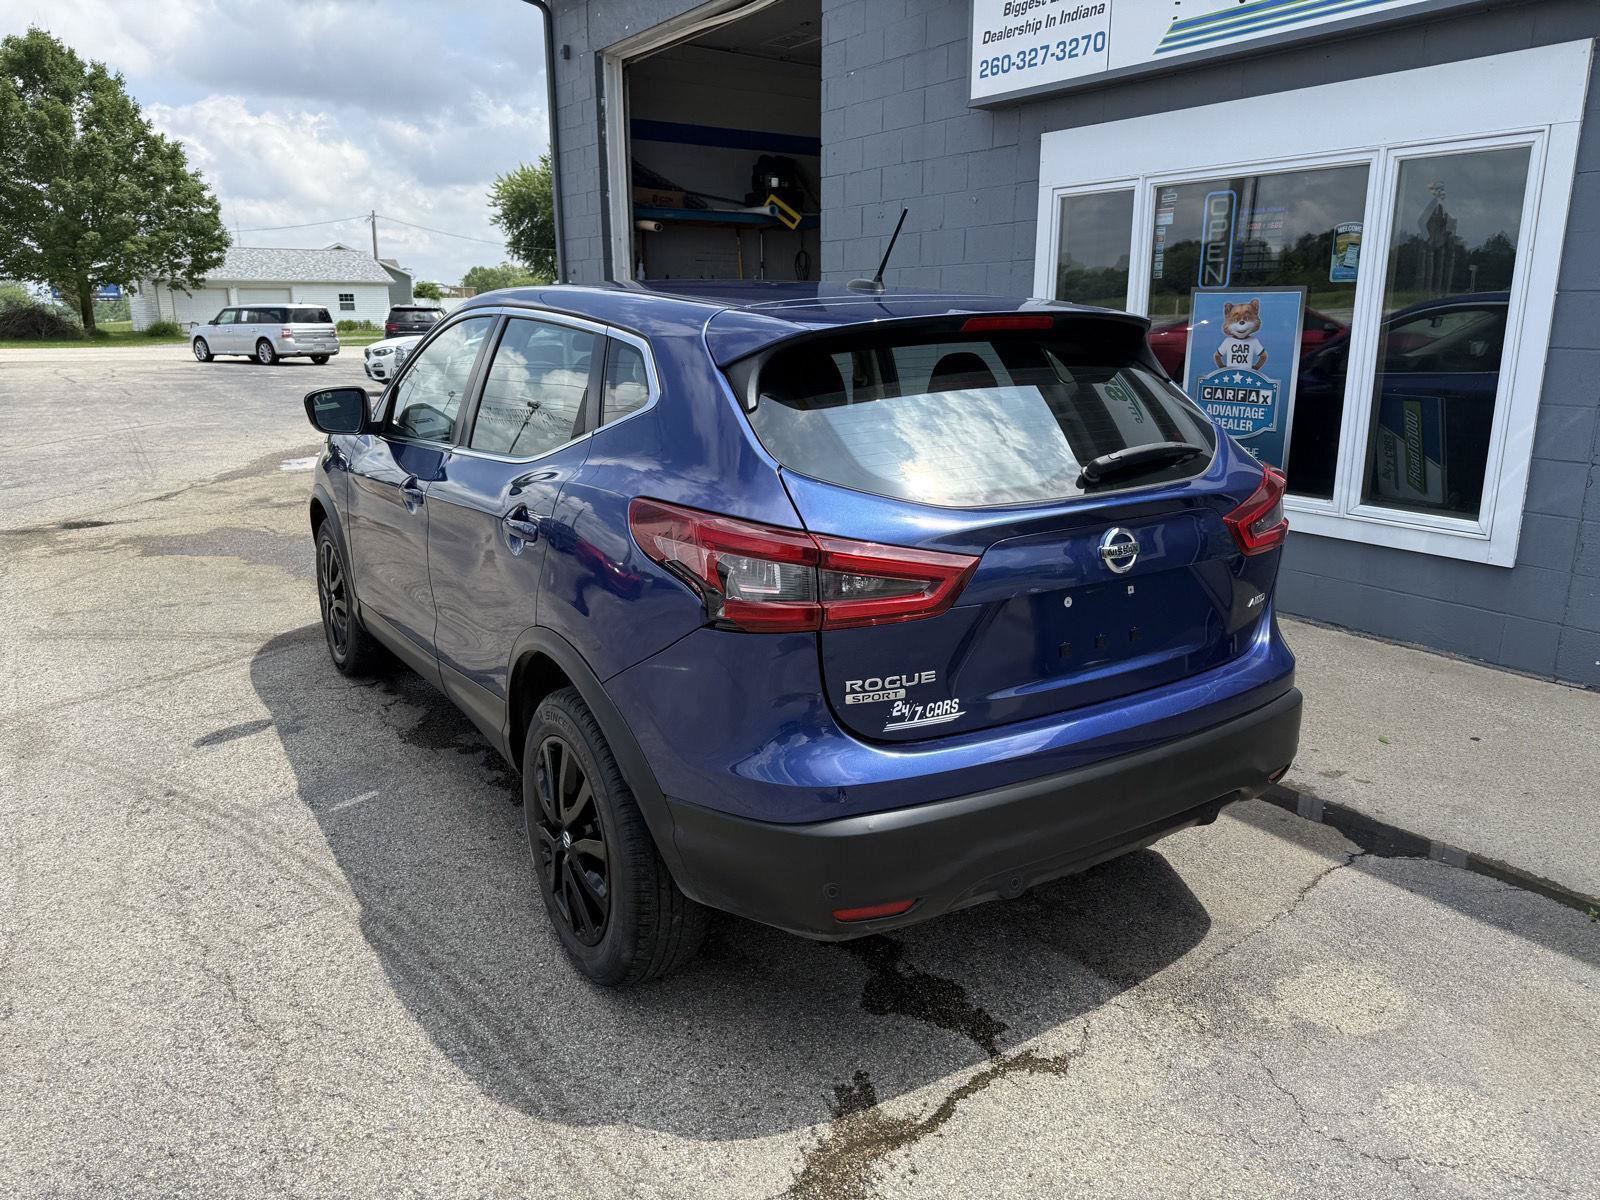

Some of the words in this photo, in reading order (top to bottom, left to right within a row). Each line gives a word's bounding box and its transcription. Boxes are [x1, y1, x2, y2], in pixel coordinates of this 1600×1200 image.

[982, 18, 1042, 45] Dealership
[1045, 14, 1057, 29] In
[1060, 3, 1106, 25] Indiana
[979, 31, 1106, 79] 260-327-3270
[1204, 197, 1229, 284] OPEN
[1231, 344, 1249, 353] CAR
[1231, 354, 1248, 364] FOX
[1204, 388, 1270, 405] CARFAX
[1206, 404, 1265, 419] ADVANTAGE
[845, 671, 936, 692] ROGUE
[852, 691, 901, 703] SPORT
[892, 701, 924, 722] 24/7
[926, 698, 960, 717] CARS
